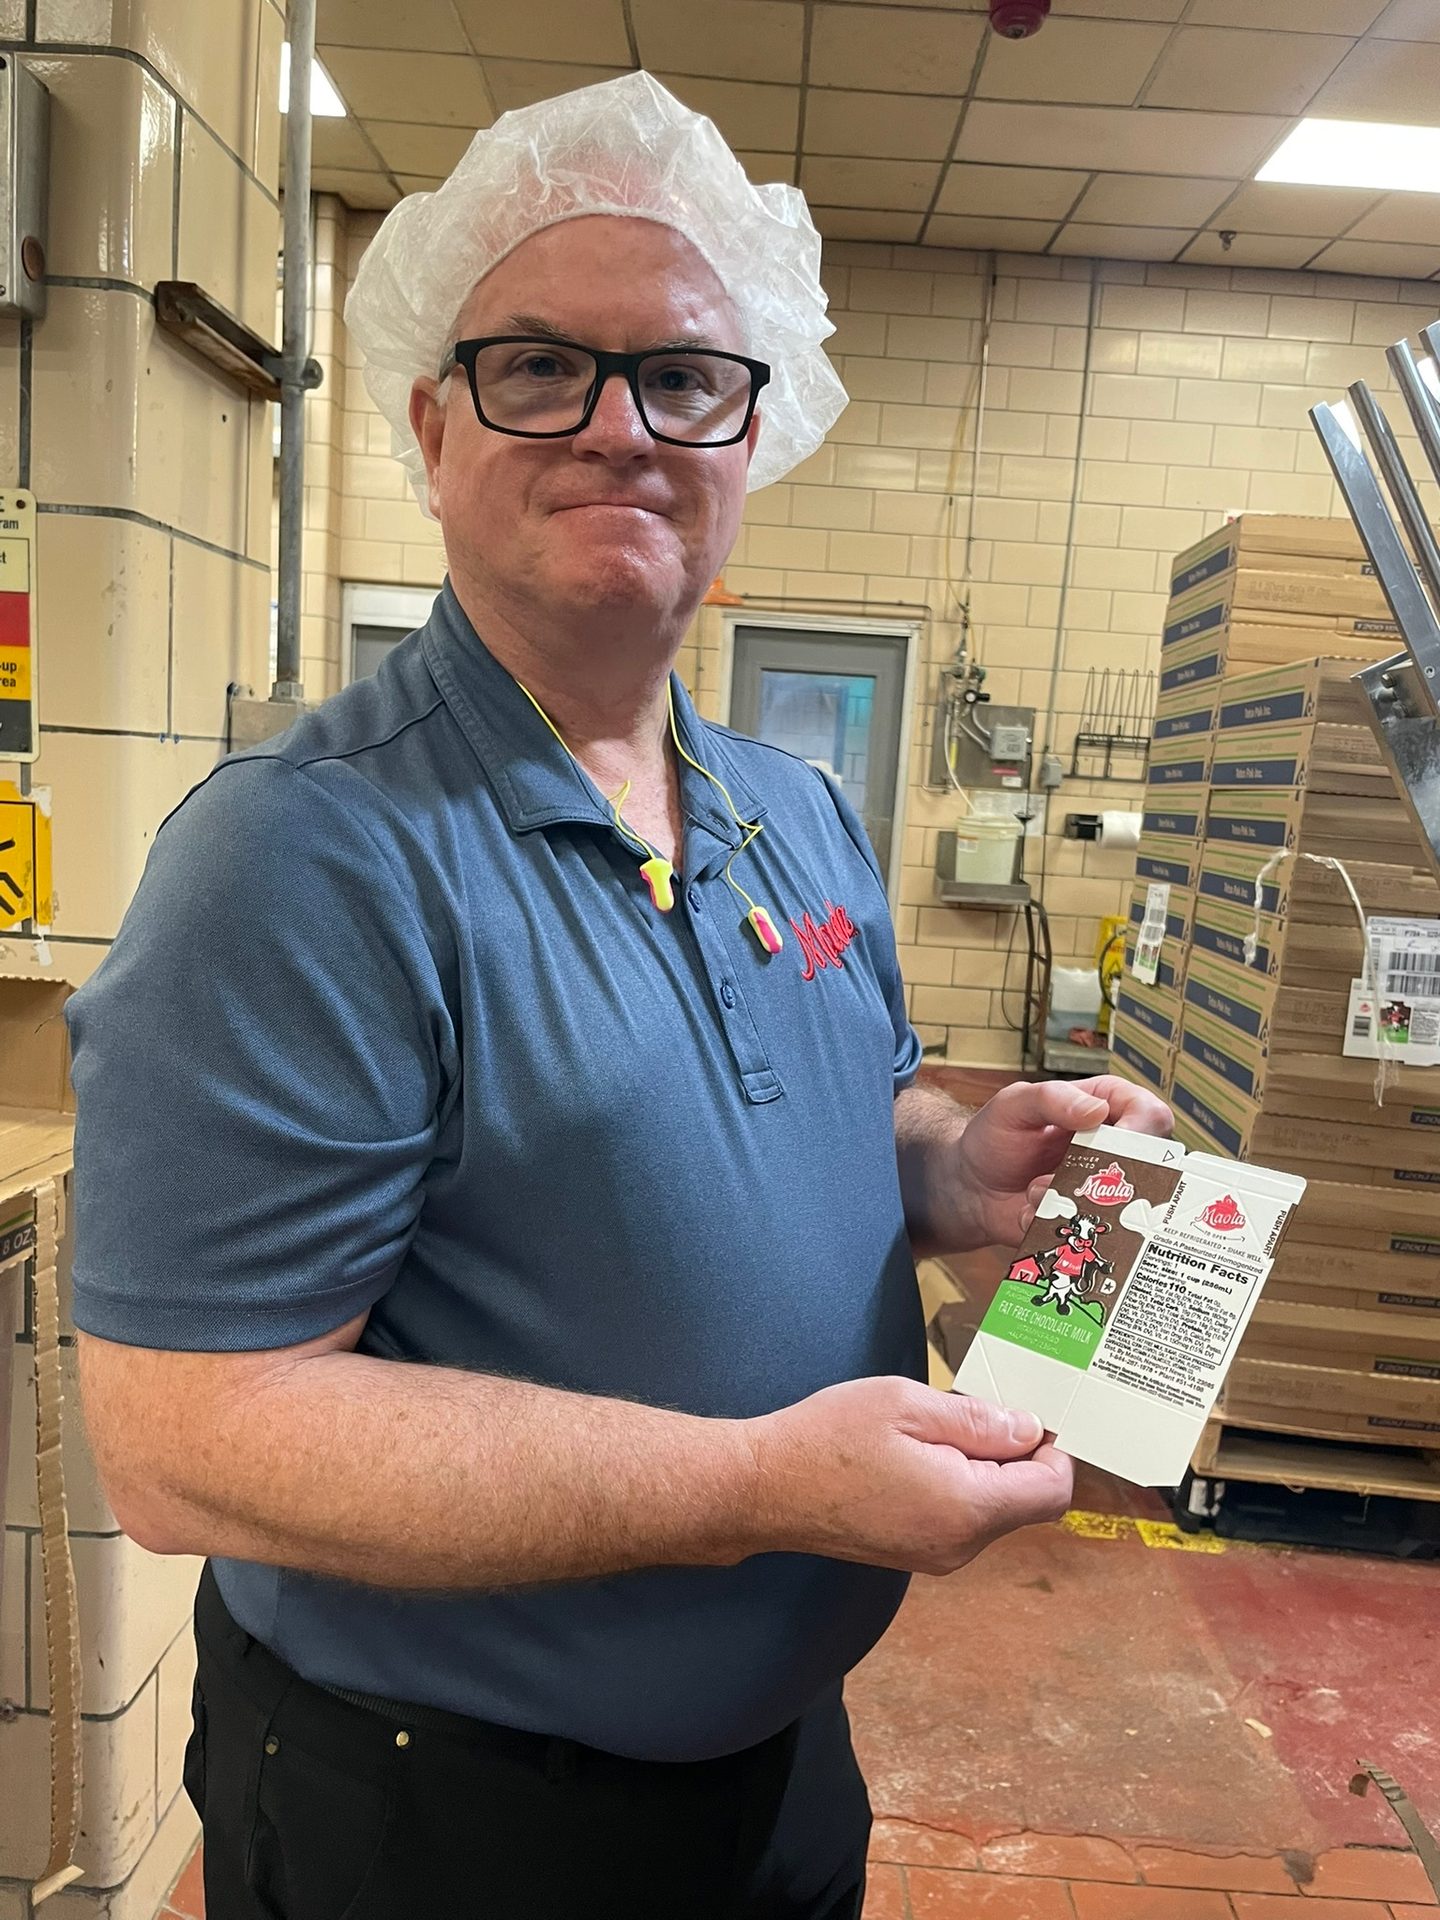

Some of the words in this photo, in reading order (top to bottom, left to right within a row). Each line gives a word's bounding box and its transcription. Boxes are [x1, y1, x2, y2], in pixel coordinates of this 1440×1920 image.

[1074, 1176, 1134, 1200] Maola
[1163, 1204, 1177, 1225] PUSH
[1172, 1181, 1187, 1204] APART
[1195, 1205, 1246, 1227] Maola
[1272, 1210, 1286, 1231] PUSH
[1152, 1234, 1173, 1244] Grade
[1178, 1243, 1216, 1259] Pasteurized
[1217, 1255, 1263, 1274] Homogenized
[1164, 1227, 1178, 1236] KEEP
[1180, 1231, 1221, 1249] REFRIGERATED
[1227, 1246, 1246, 1256] SHAKE
[1247, 1253, 1262, 1263] WELL
[1263, 1232, 1279, 1256] APART
[1141, 1259, 1160, 1268] Serv.
[1185, 1275, 1200, 1283] cup
[1144, 1253, 1173, 1266] Servings:
[1147, 1243, 1207, 1270] Nutrition
[1209, 1263, 1250, 1284] Facts
[1135, 1271, 1168, 1287] Calories
[999, 1300, 1012, 1314] FAT
[1012, 1305, 1031, 1322] FREE
[1030, 1311, 1072, 1336] CHOCOLATE
[1070, 1326, 1094, 1344] MILK
[1142, 1358, 1168, 1372] Newport
[1186, 1374, 1196, 1382] VA
